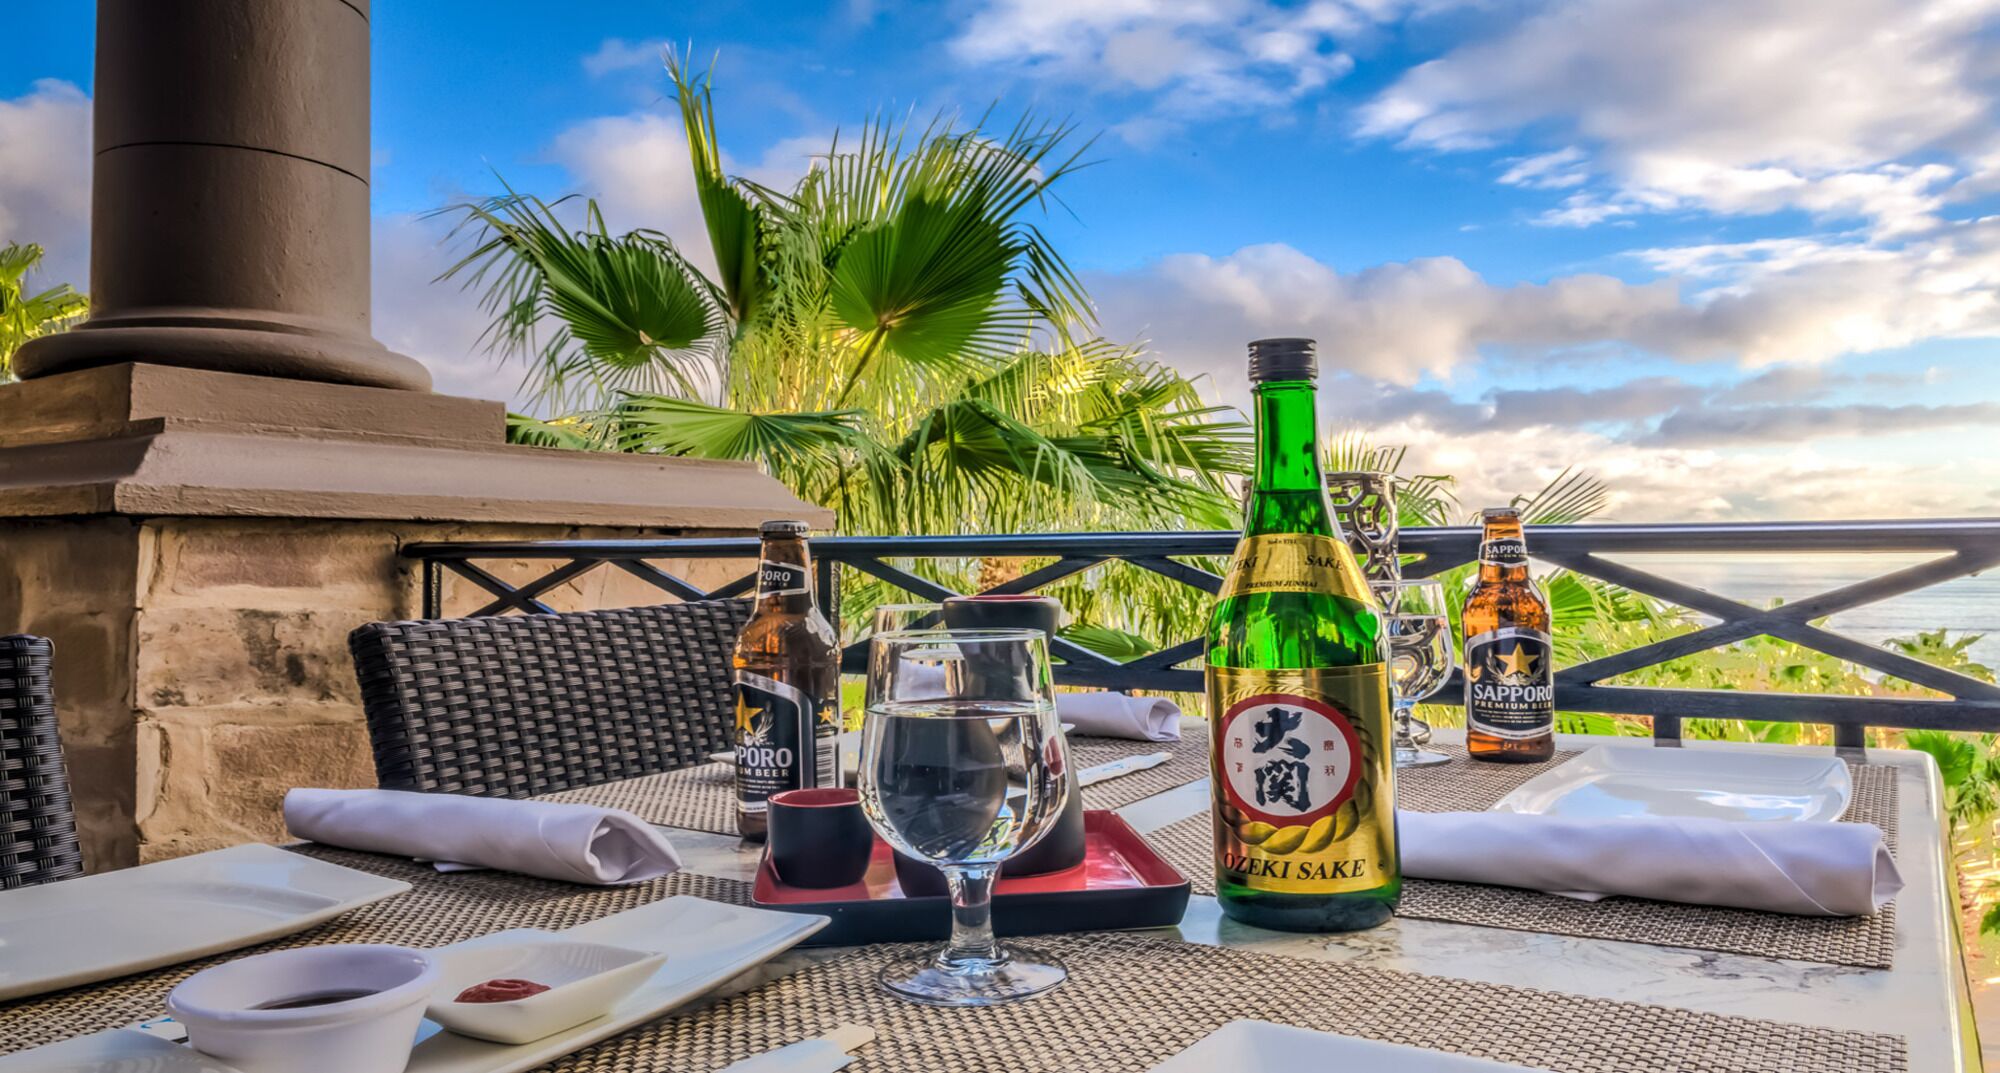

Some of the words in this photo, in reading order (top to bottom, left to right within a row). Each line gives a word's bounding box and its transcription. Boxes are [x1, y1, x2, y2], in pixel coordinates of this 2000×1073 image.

[1305, 554, 1343, 570] SAKE
[1473, 683, 1553, 702] SAPPORO
[1474, 699, 1529, 709] PREMIUM
[755, 768, 789, 777] BEER
[1223, 853, 1292, 879] OZEKI
[1296, 858, 1366, 880] SAKE
